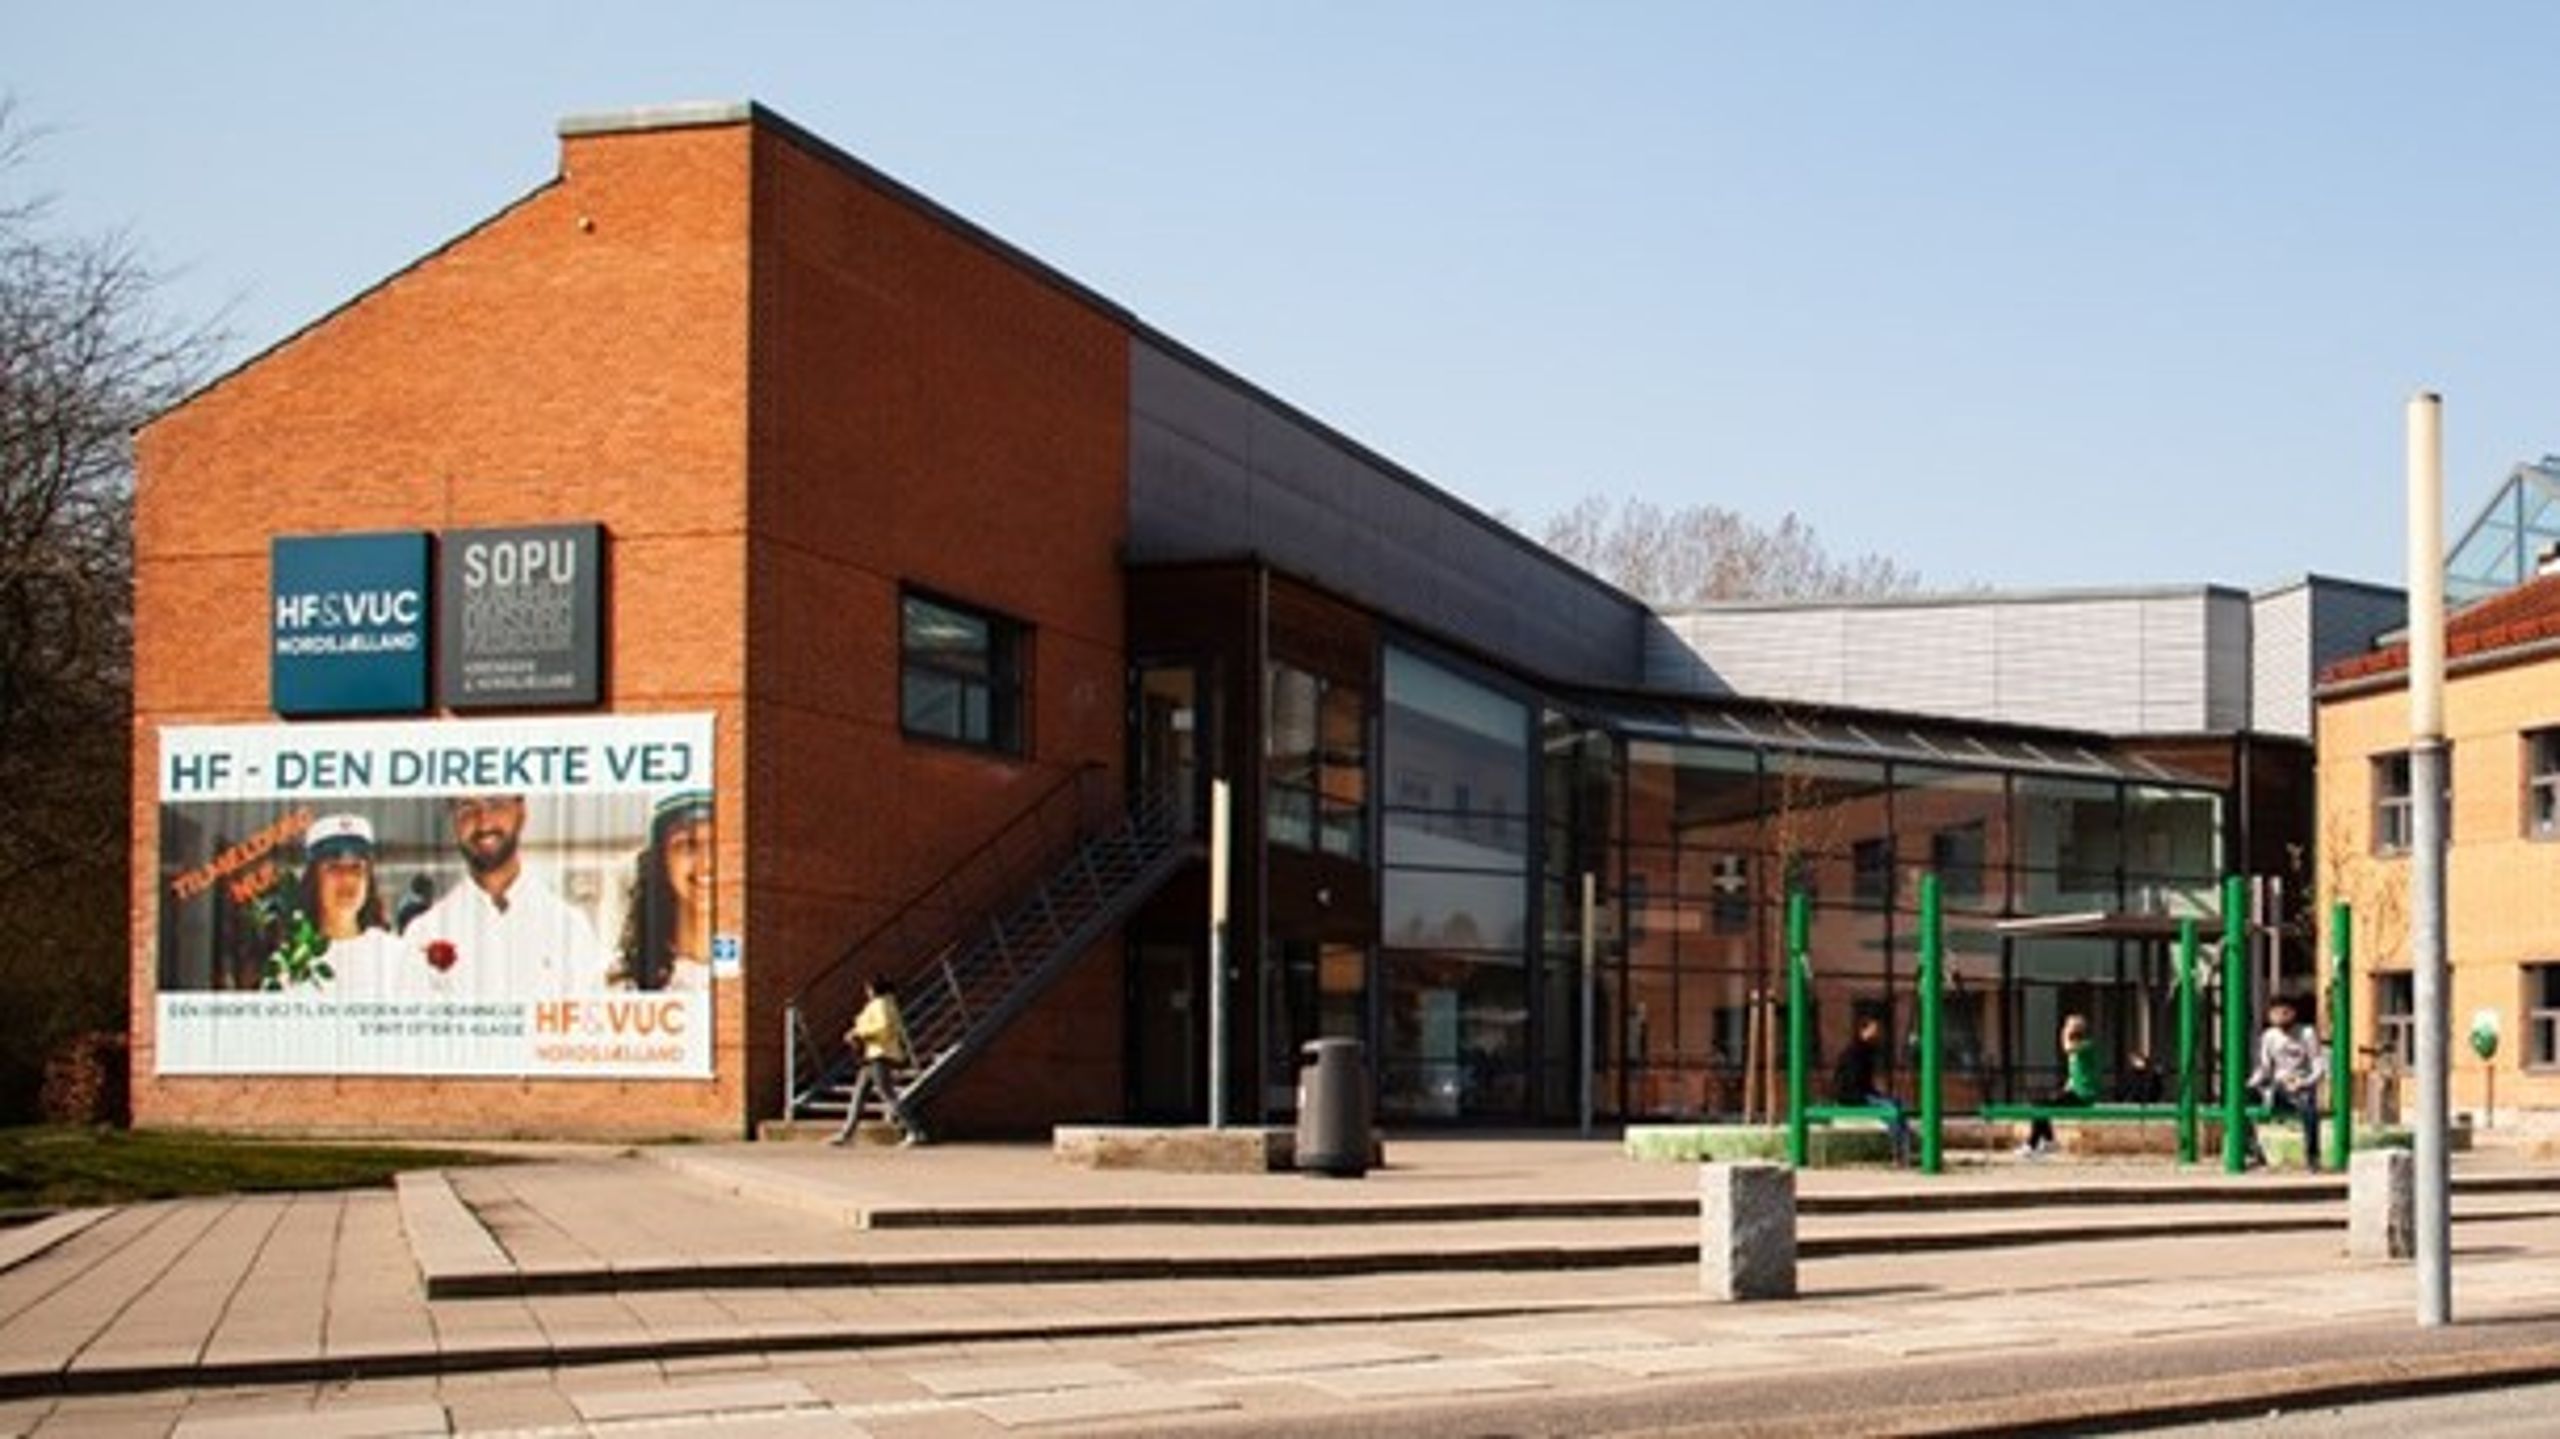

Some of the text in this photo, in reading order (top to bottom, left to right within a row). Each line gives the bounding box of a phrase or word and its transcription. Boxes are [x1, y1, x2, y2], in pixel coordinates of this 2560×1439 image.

[463, 539, 577, 588] SOPU
[276, 590, 419, 628] HF&VUC
[170, 754, 232, 791] HF
[275, 750, 374, 789] DEN
[388, 746, 590, 787] DIREKTE
[604, 743, 692, 783] VEJ
[536, 1000, 685, 1036] HF&VUC
